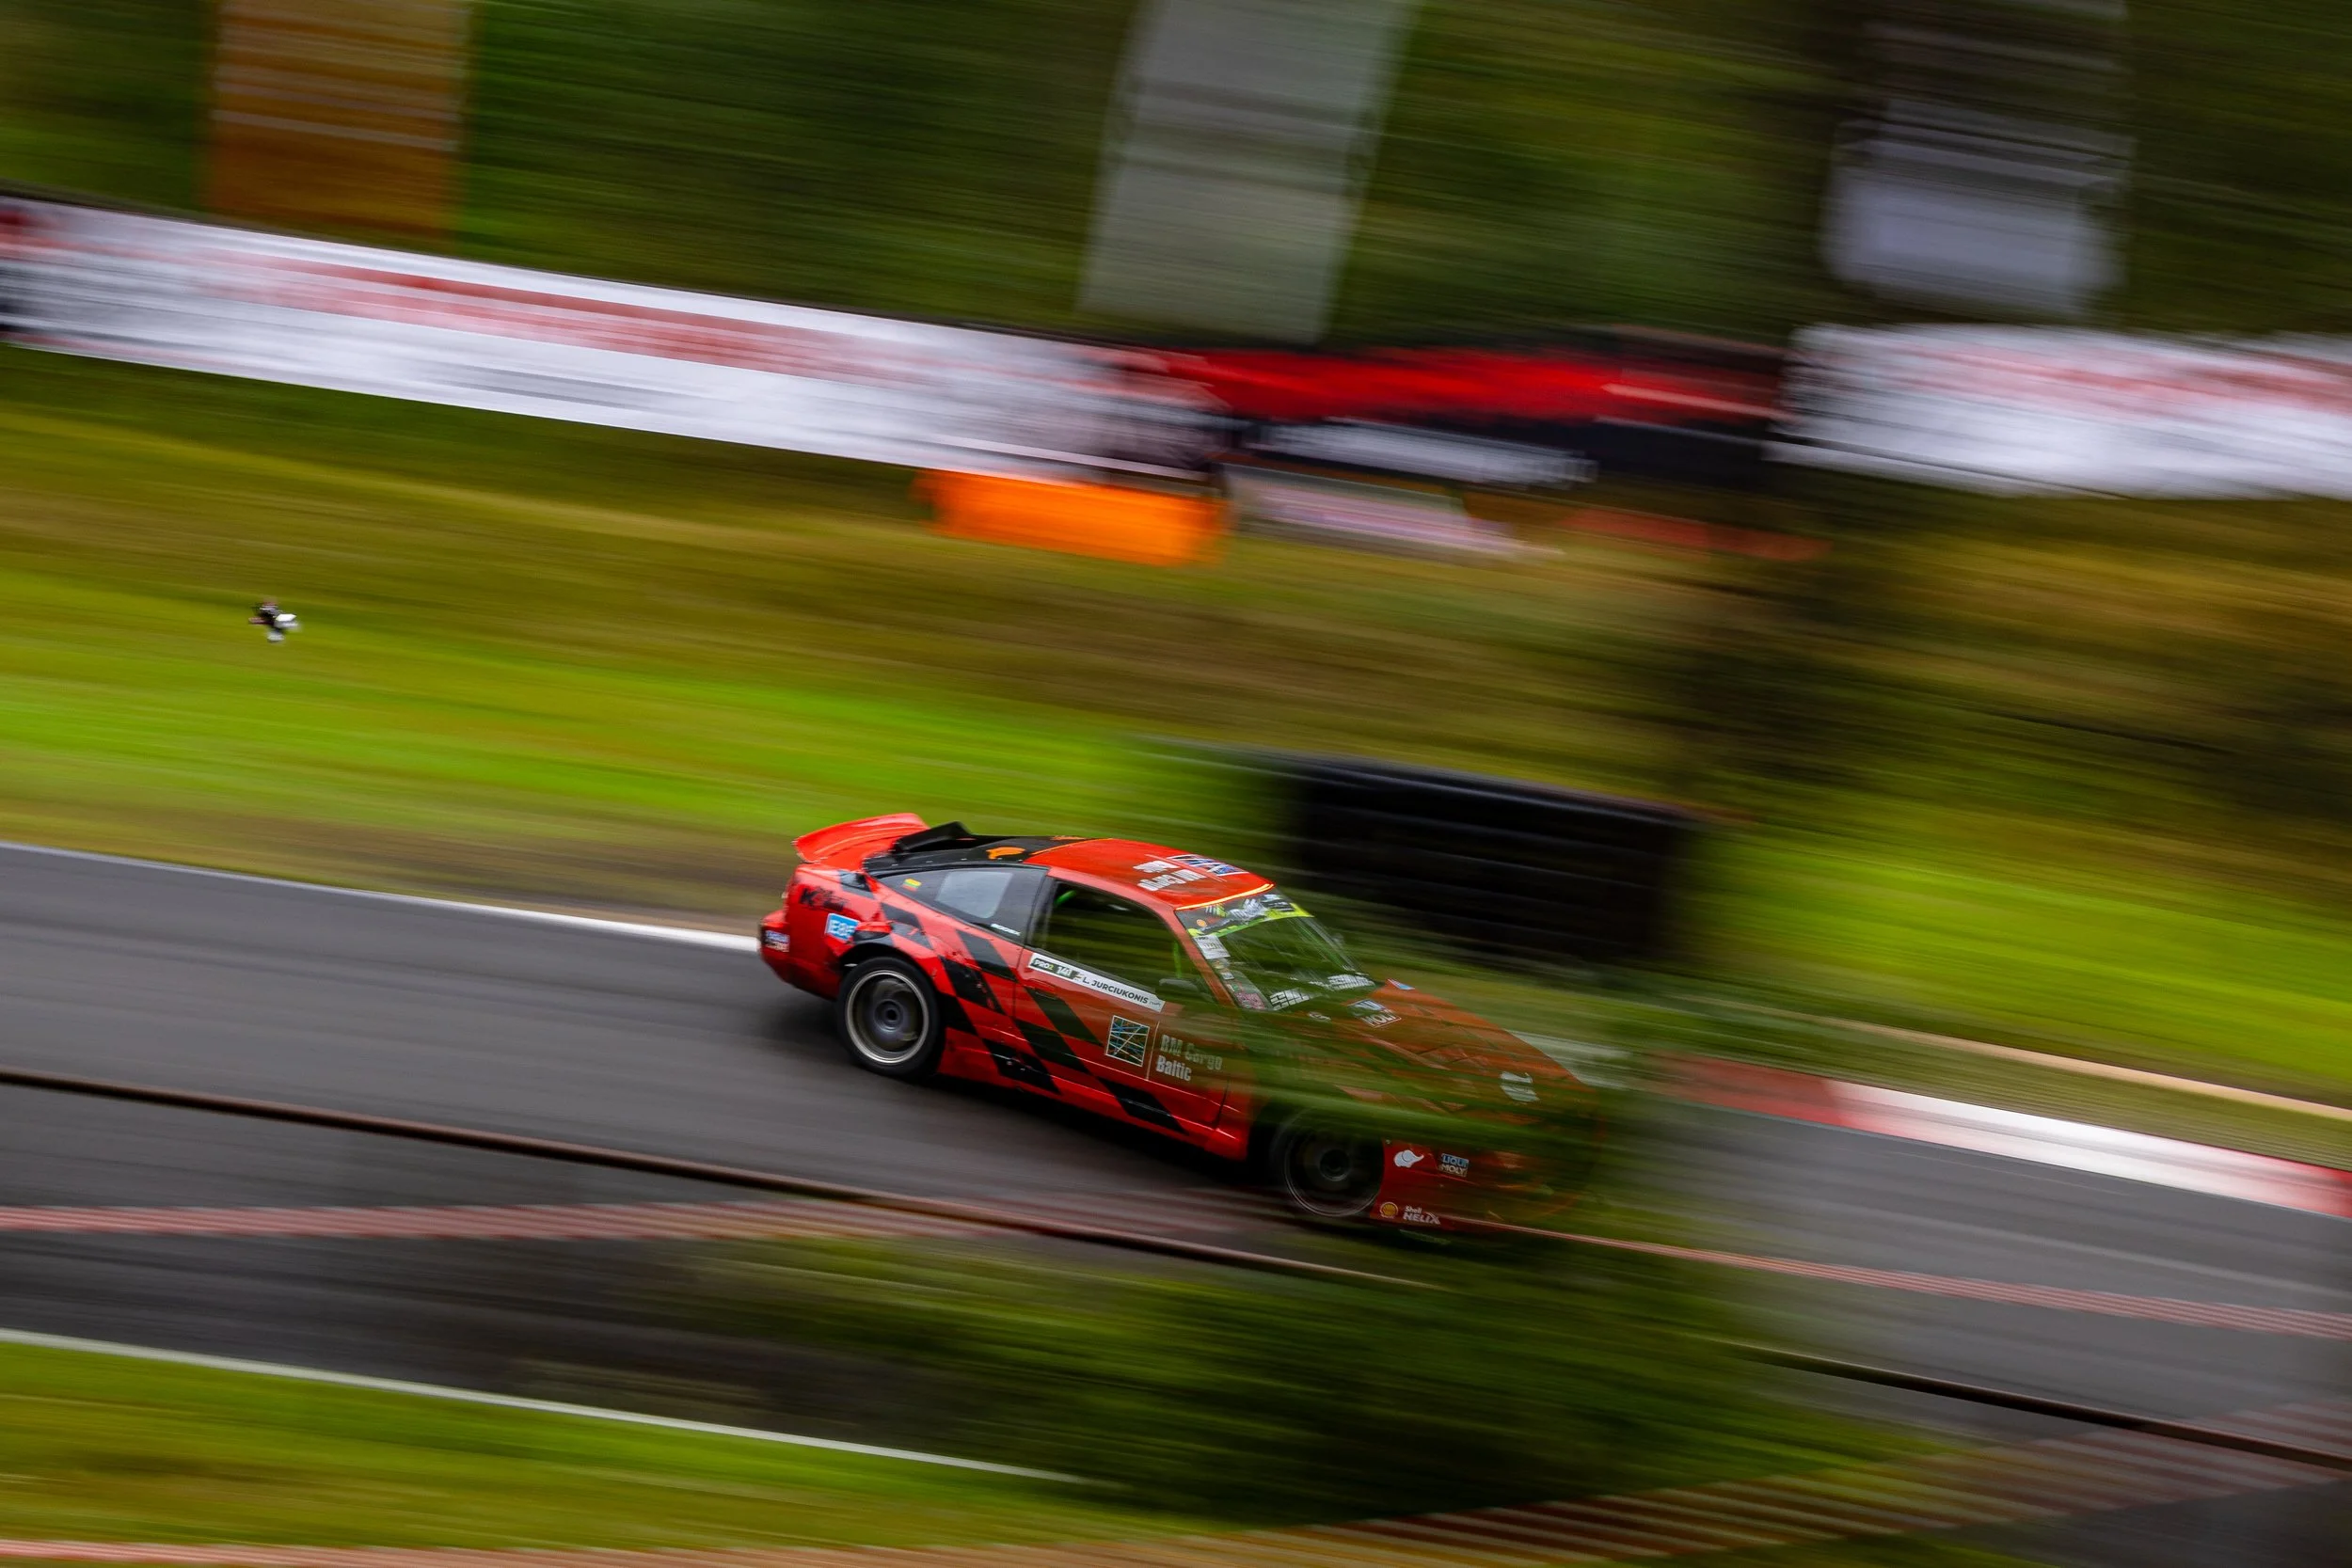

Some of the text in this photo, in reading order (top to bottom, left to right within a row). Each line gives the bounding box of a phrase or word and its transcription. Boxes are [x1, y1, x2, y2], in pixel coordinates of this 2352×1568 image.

[1083, 976, 1090, 985] L.
[1091, 979, 1149, 1005] JURCIUKONIS
[1156, 1054, 1193, 1082] Baltic
[1440, 1164, 1467, 1177] MOLY
